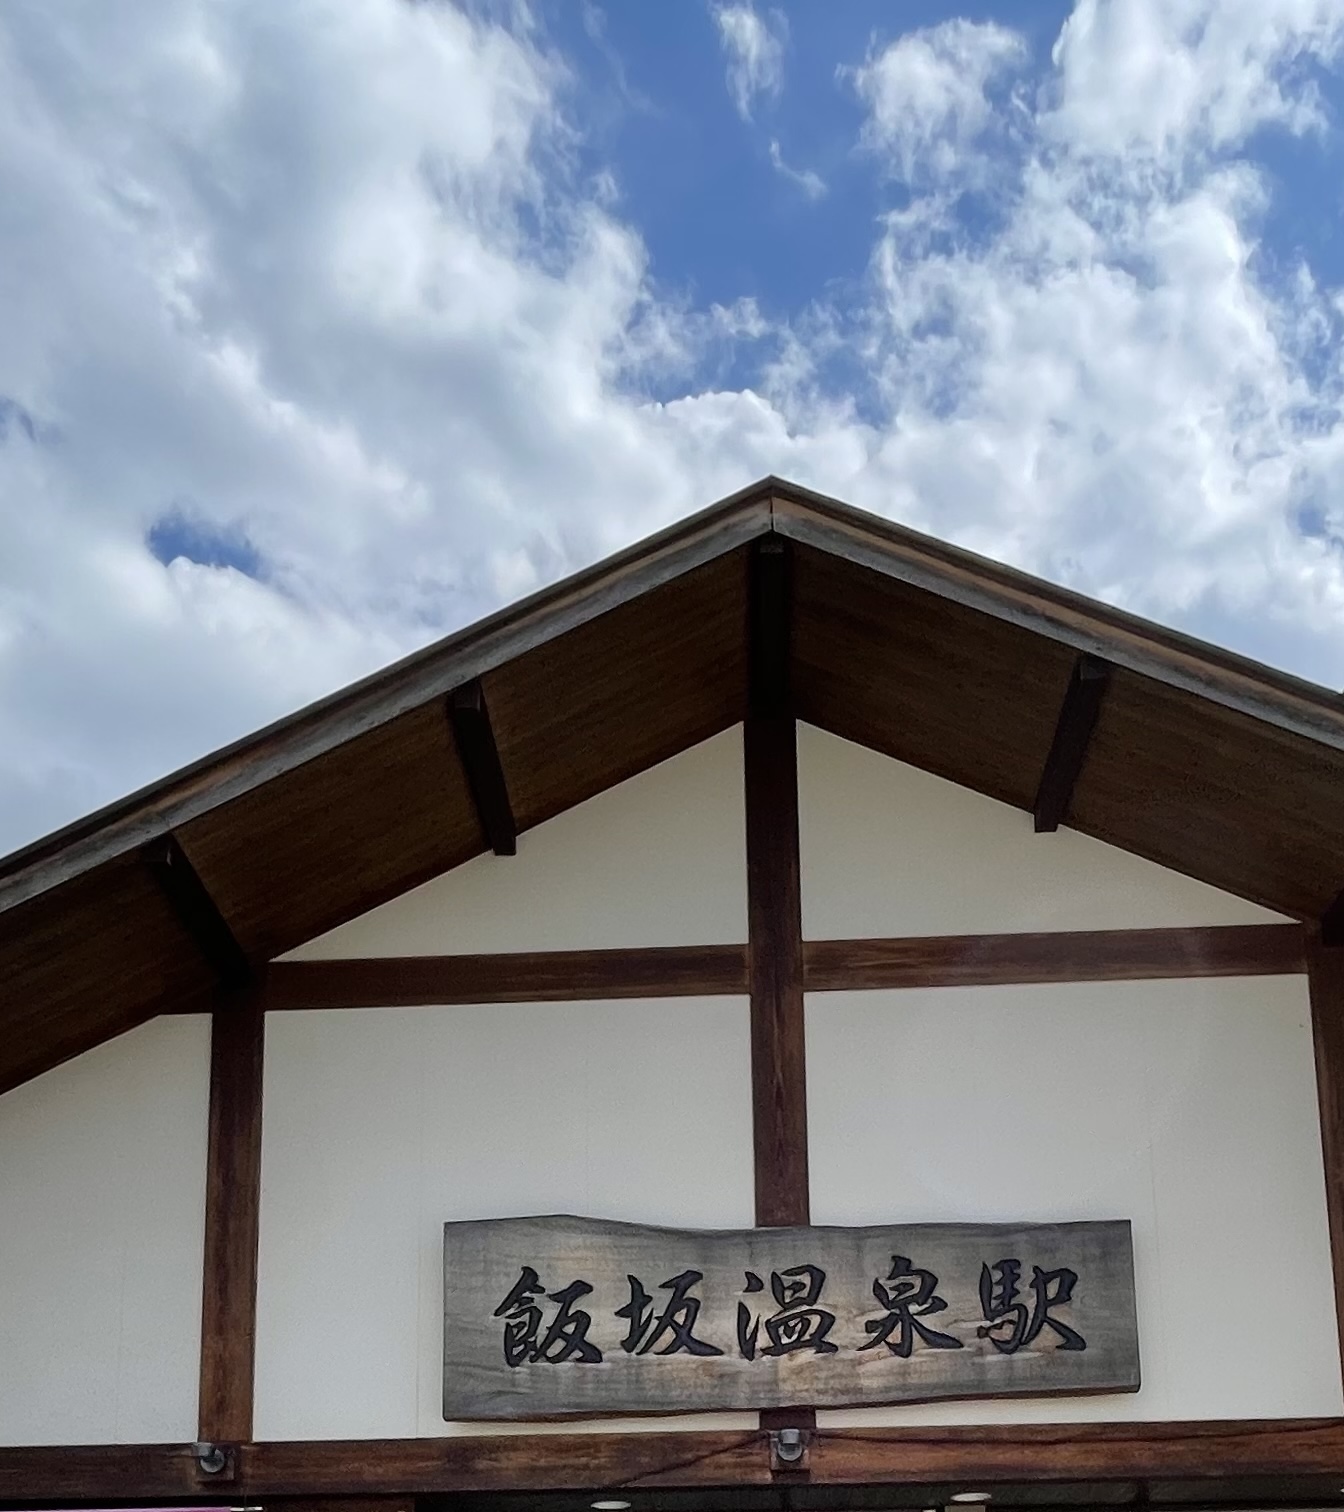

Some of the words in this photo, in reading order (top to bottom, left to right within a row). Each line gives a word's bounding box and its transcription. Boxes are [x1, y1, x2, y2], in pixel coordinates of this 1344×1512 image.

[493, 1255, 1086, 1368] 飯坂温泉駅
